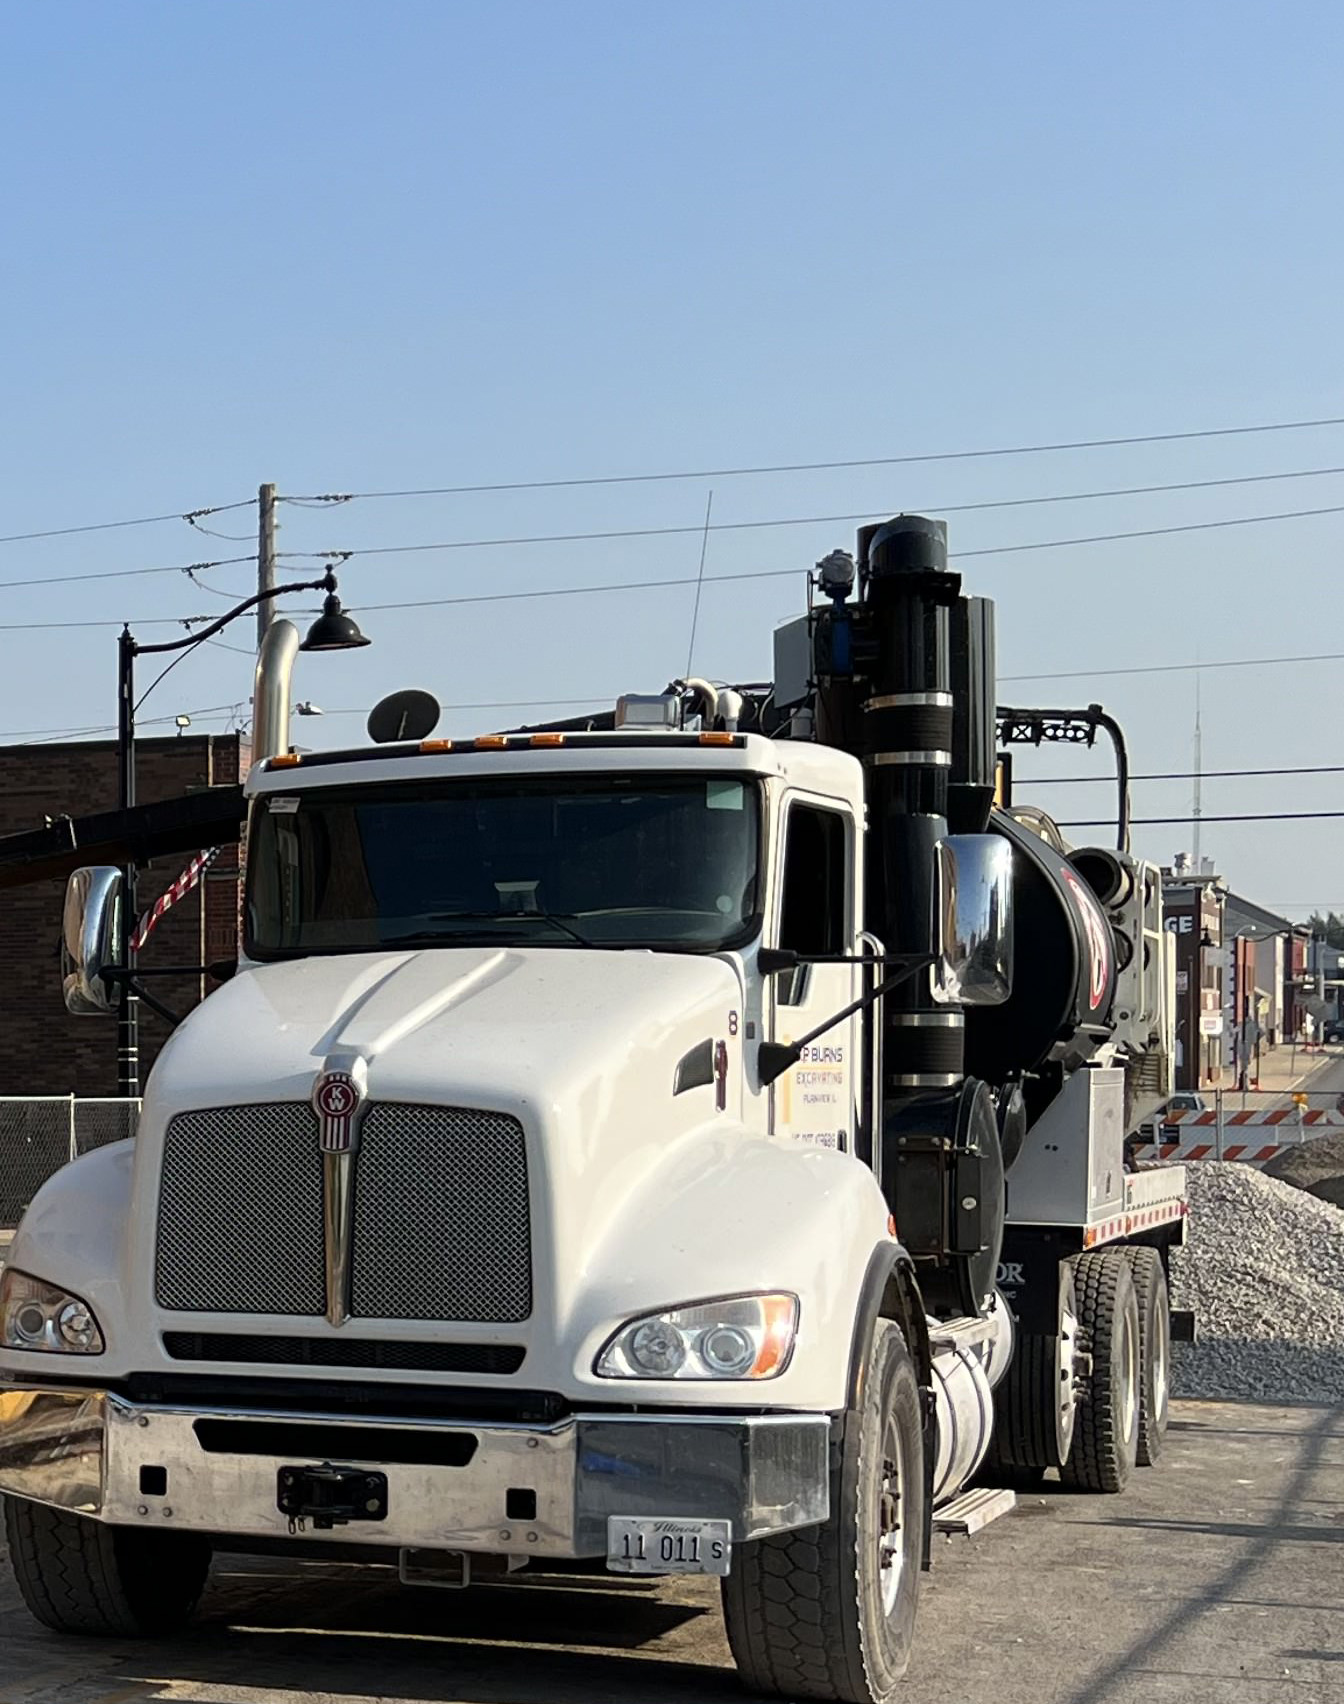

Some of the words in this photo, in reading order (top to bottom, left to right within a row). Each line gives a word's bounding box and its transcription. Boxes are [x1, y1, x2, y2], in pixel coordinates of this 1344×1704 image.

[811, 1046, 843, 1063] BURNS
[653, 1521, 703, 1533] Illinois
[621, 1534, 647, 1560] 11
[660, 1535, 701, 1562] 011
